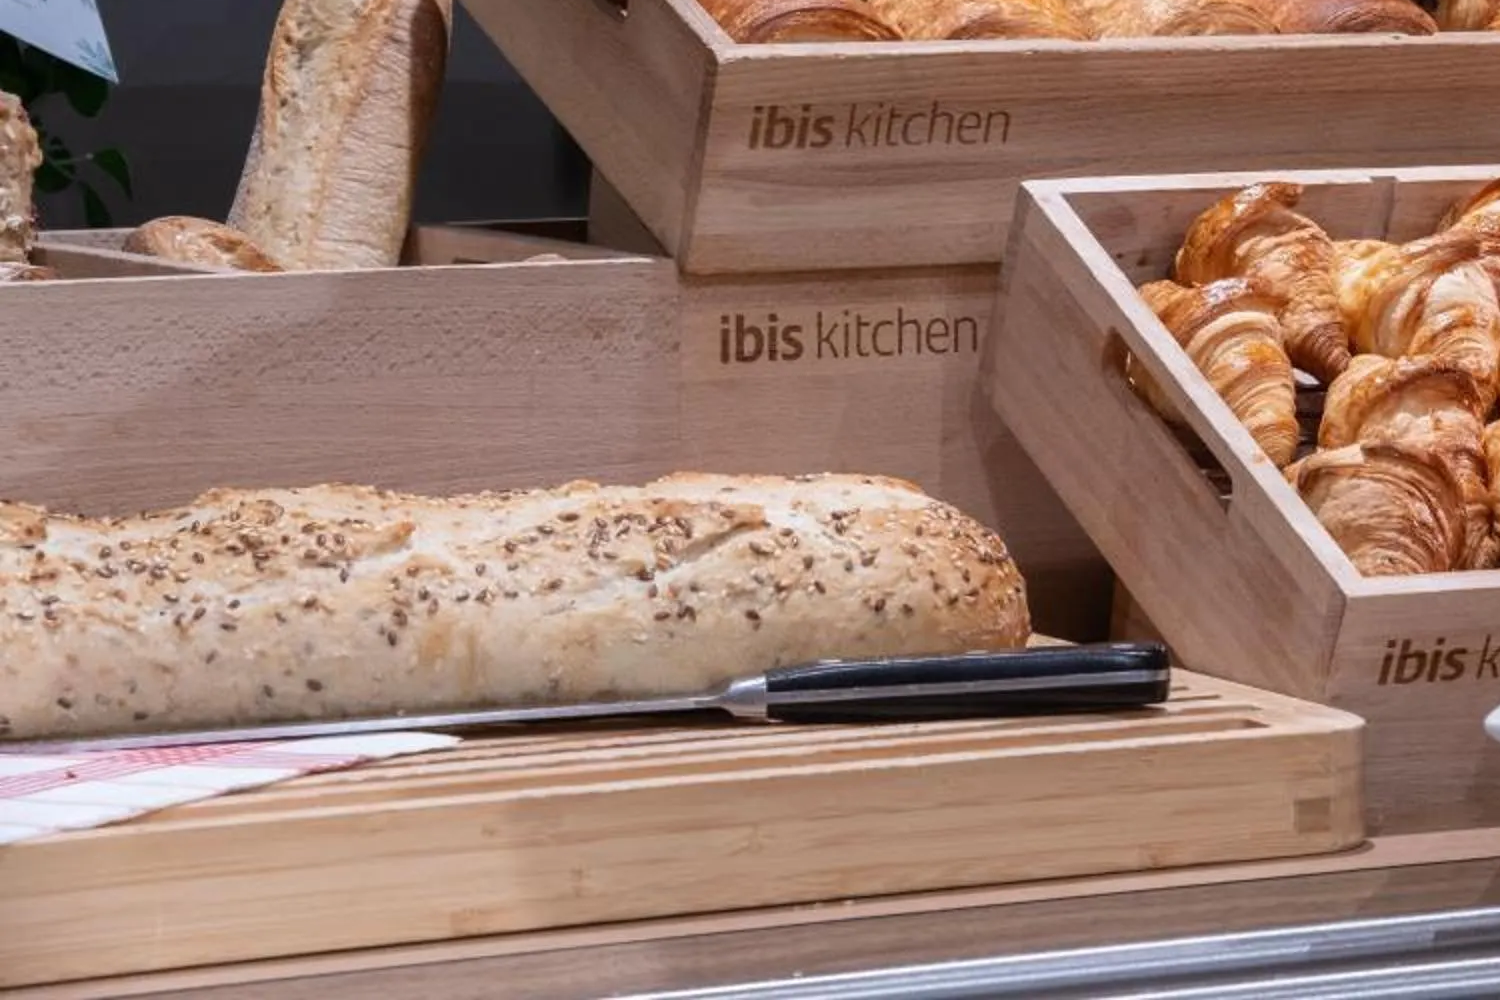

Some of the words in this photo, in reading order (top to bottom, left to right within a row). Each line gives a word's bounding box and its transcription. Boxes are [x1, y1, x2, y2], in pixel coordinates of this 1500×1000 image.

[748, 103, 834, 151] ibis
[845, 100, 1012, 148] kitchen
[719, 312, 804, 364] ibis
[815, 306, 979, 360] kitchen
[1377, 636, 1468, 686] ibis
